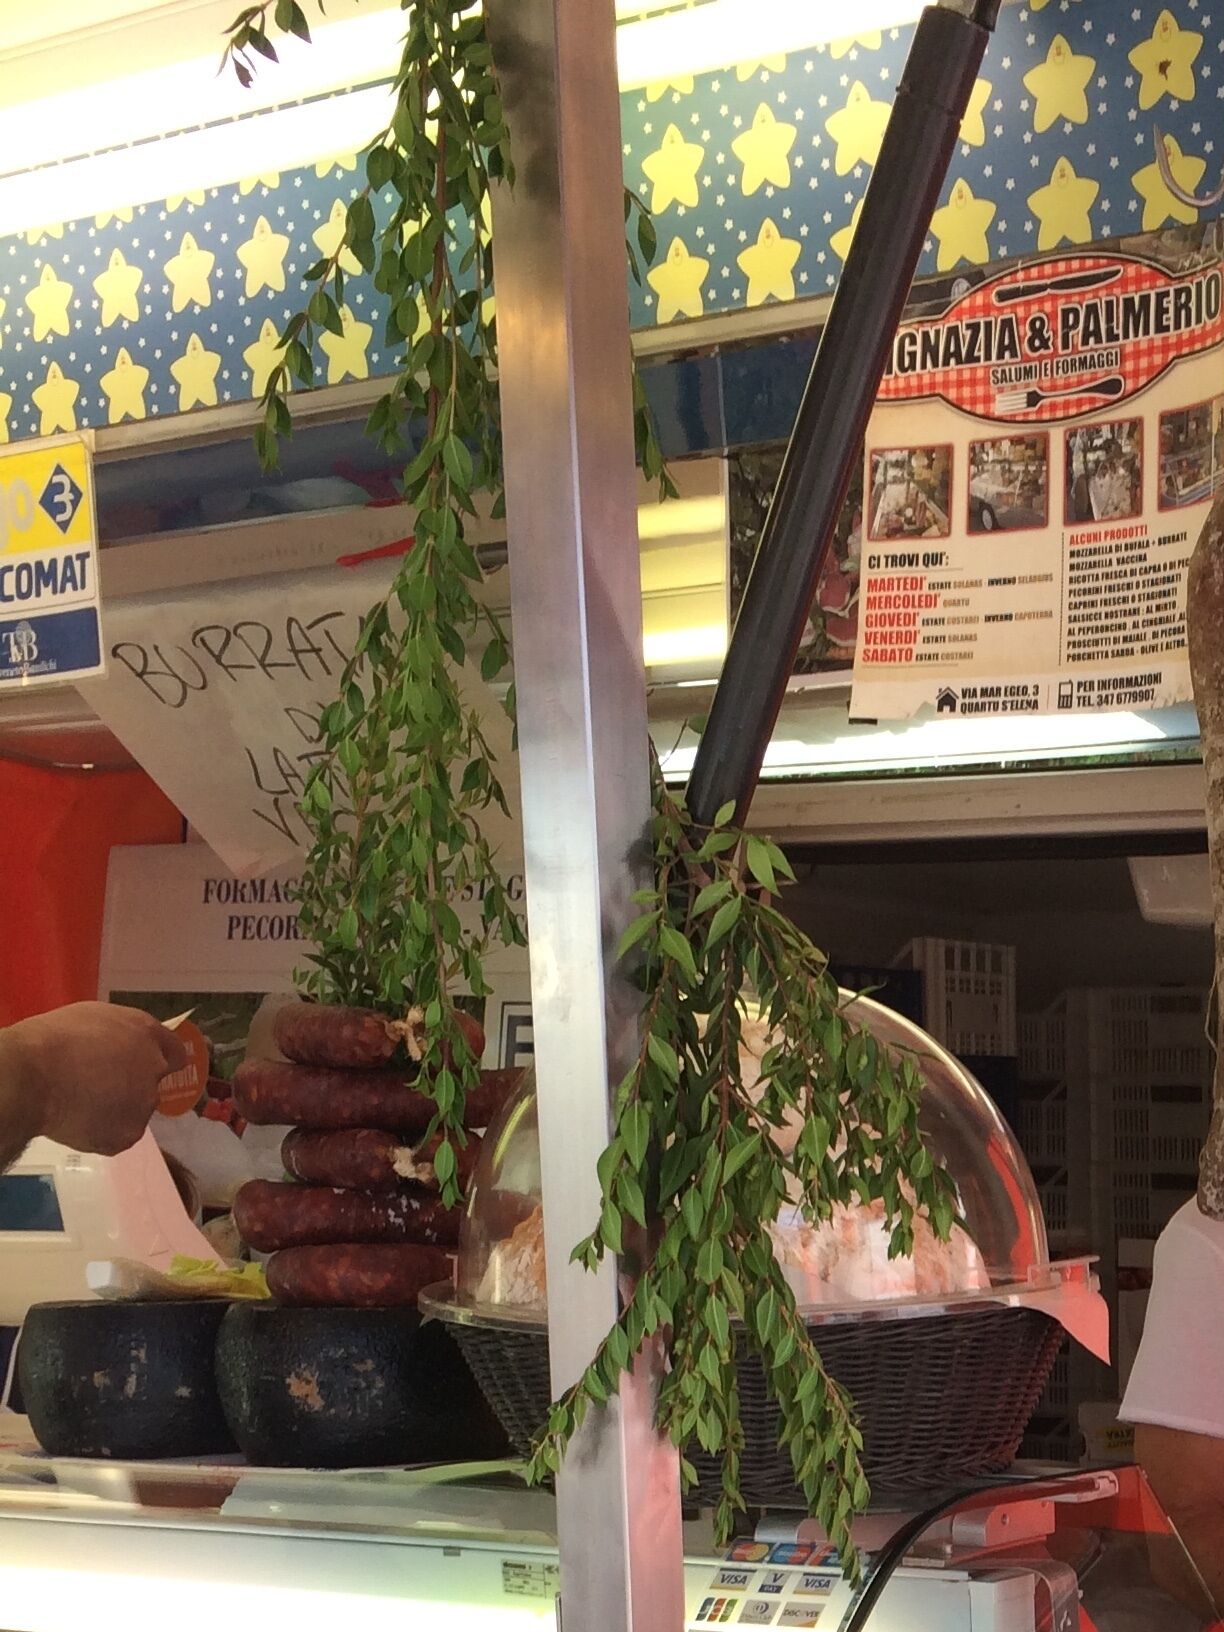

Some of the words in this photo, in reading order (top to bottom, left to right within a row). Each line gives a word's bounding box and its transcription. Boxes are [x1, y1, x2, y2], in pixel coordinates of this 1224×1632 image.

[1026, 315, 1052, 354] &
[1060, 272, 1222, 351] PALMERIO
[992, 365, 1038, 384] SALUMI
[1043, 361, 1051, 377] E
[1055, 351, 1119, 375] FORMAGGI
[1069, 531, 1102, 546] ALCUNI
[1104, 525, 1148, 541] PRODOTTI
[1069, 545, 1113, 559] MOZZARELLA
[868, 555, 881, 569] CI
[883, 553, 920, 568] TROVI
[1069, 558, 1113, 572] MOZZARELLA
[1116, 553, 1147, 566] VACCINA
[0, 551, 90, 602] COMAT
[1069, 573, 1099, 585] RICOTTA
[1101, 568, 1128, 581] FRESCA
[928, 581, 951, 591] ESTATE
[922, 617, 945, 627] ESTATE
[922, 635, 946, 644] ESTATE
[112, 611, 365, 708] BURRAT
[862, 647, 913, 663] SABATO
[915, 652, 939, 661] ESTATE
[1077, 679, 1095, 694] PER
[1097, 672, 1162, 692] INFORMAZIONI
[961, 688, 978, 699] VIA
[979, 686, 1001, 699] MAR
[1032, 684, 1040, 696] 3
[960, 701, 999, 714] QUARTU
[1077, 695, 1094, 708] TEL.
[227, 914, 307, 940] PECOR
[720, 1573, 747, 1585] VISA
[805, 1578, 831, 1589] VISA
